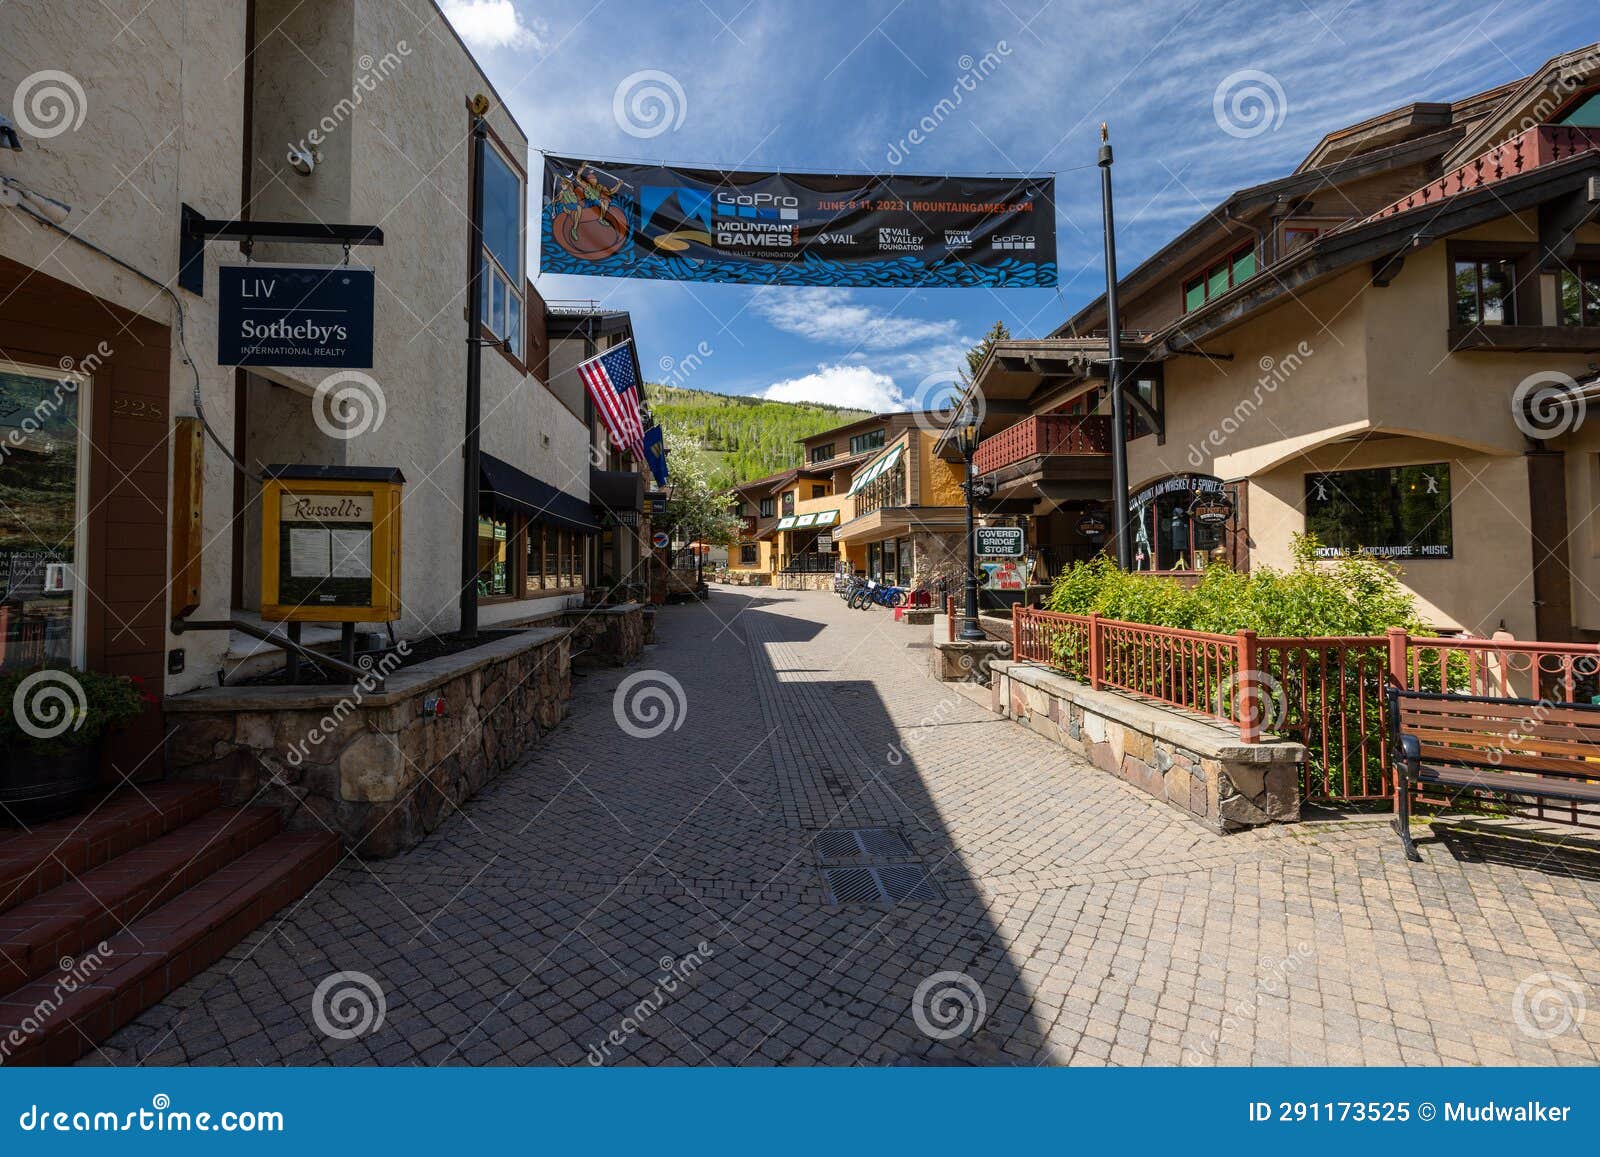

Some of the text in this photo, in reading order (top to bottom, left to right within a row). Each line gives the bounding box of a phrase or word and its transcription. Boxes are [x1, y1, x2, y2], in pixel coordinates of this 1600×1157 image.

[717, 192, 799, 207] GoPro
[817, 201, 845, 210] JUNE
[876, 200, 904, 211] 2023
[912, 201, 1034, 213] MOUNTAINGAMES.COM
[717, 222, 792, 233] MOUNTAIN
[891, 228, 911, 236] VAIL
[717, 233, 792, 247] GAMES
[829, 234, 858, 245] VAIL
[891, 236, 924, 244] VALLEY
[944, 235, 973, 245] VAIL
[991, 234, 1036, 242] GoPro
[879, 243, 924, 251] FOUNDATION
[241, 278, 276, 298] LIV
[240, 318, 348, 344] Sotheby's
[240, 346, 346, 357] INTERNATIONAL REALTY
[288, 498, 363, 519] Russell's
[978, 530, 1020, 538] COVERED
[983, 538, 1016, 546] BRIDGE
[1358, 545, 1413, 556] MERCHANDISE
[1421, 544, 1449, 555] MUSIC
